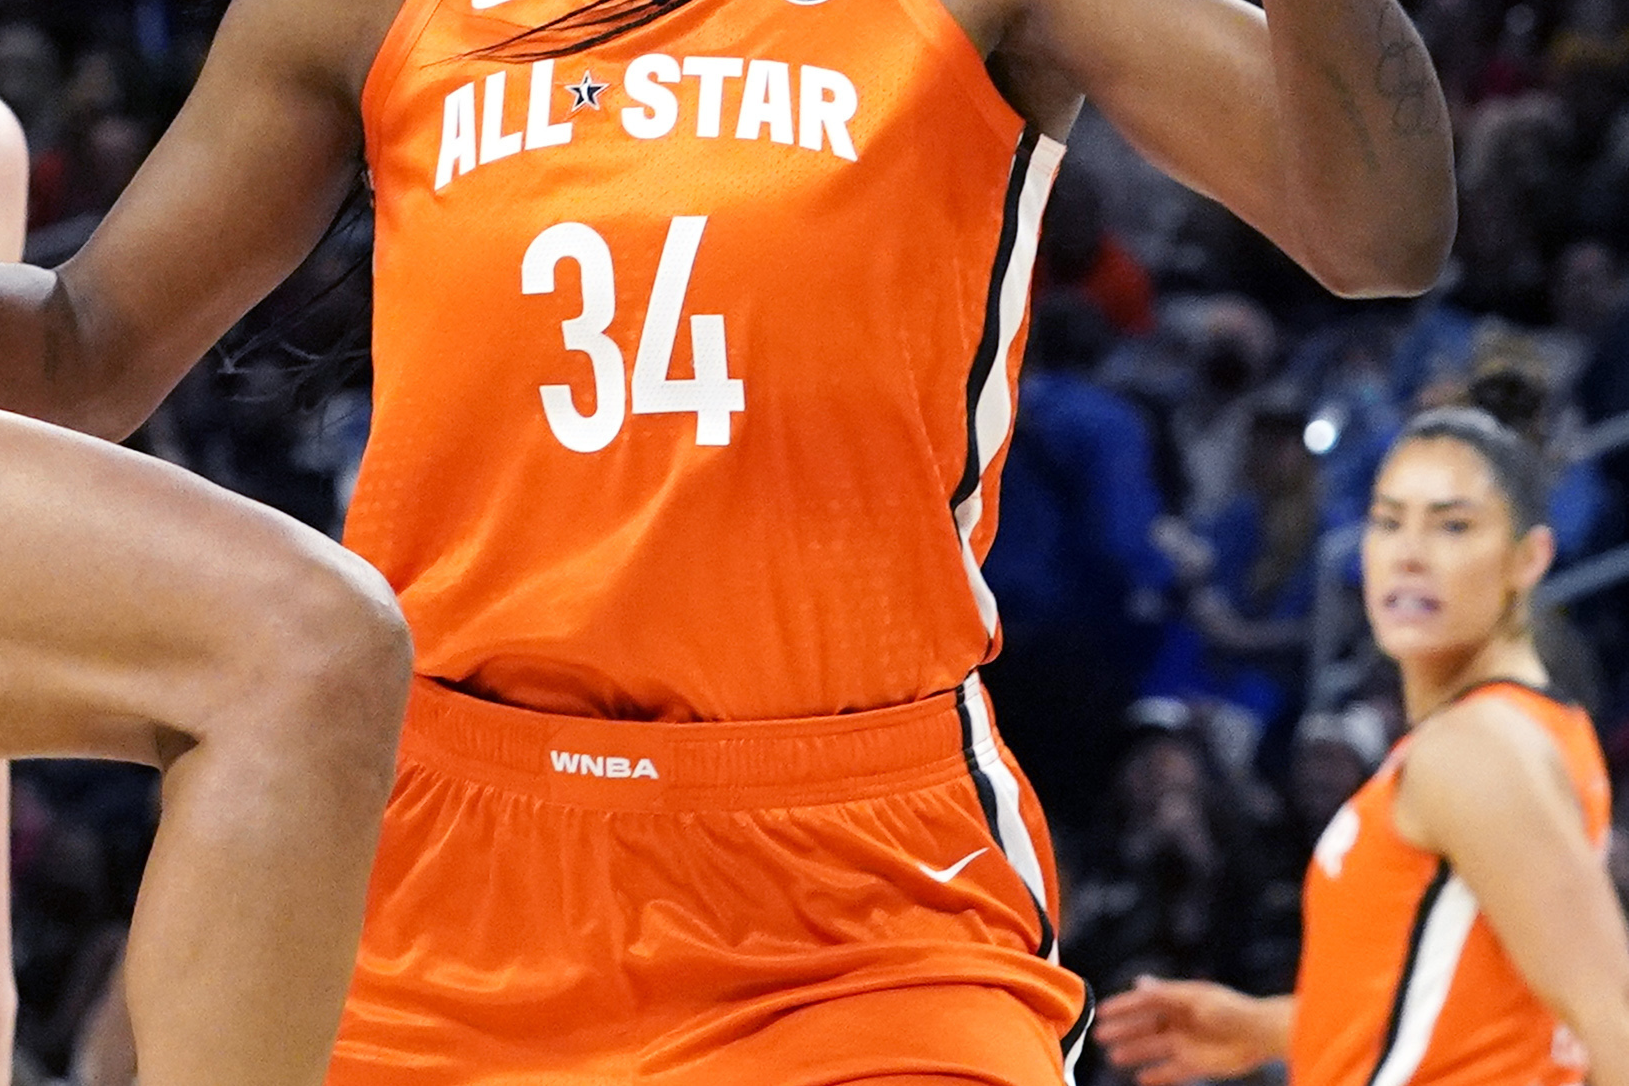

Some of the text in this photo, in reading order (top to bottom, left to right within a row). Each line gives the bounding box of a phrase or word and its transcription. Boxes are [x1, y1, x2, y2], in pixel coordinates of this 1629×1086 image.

[434, 52, 859, 192] ALL STAR
[521, 215, 746, 454] 34
[550, 750, 659, 780] WNBA
